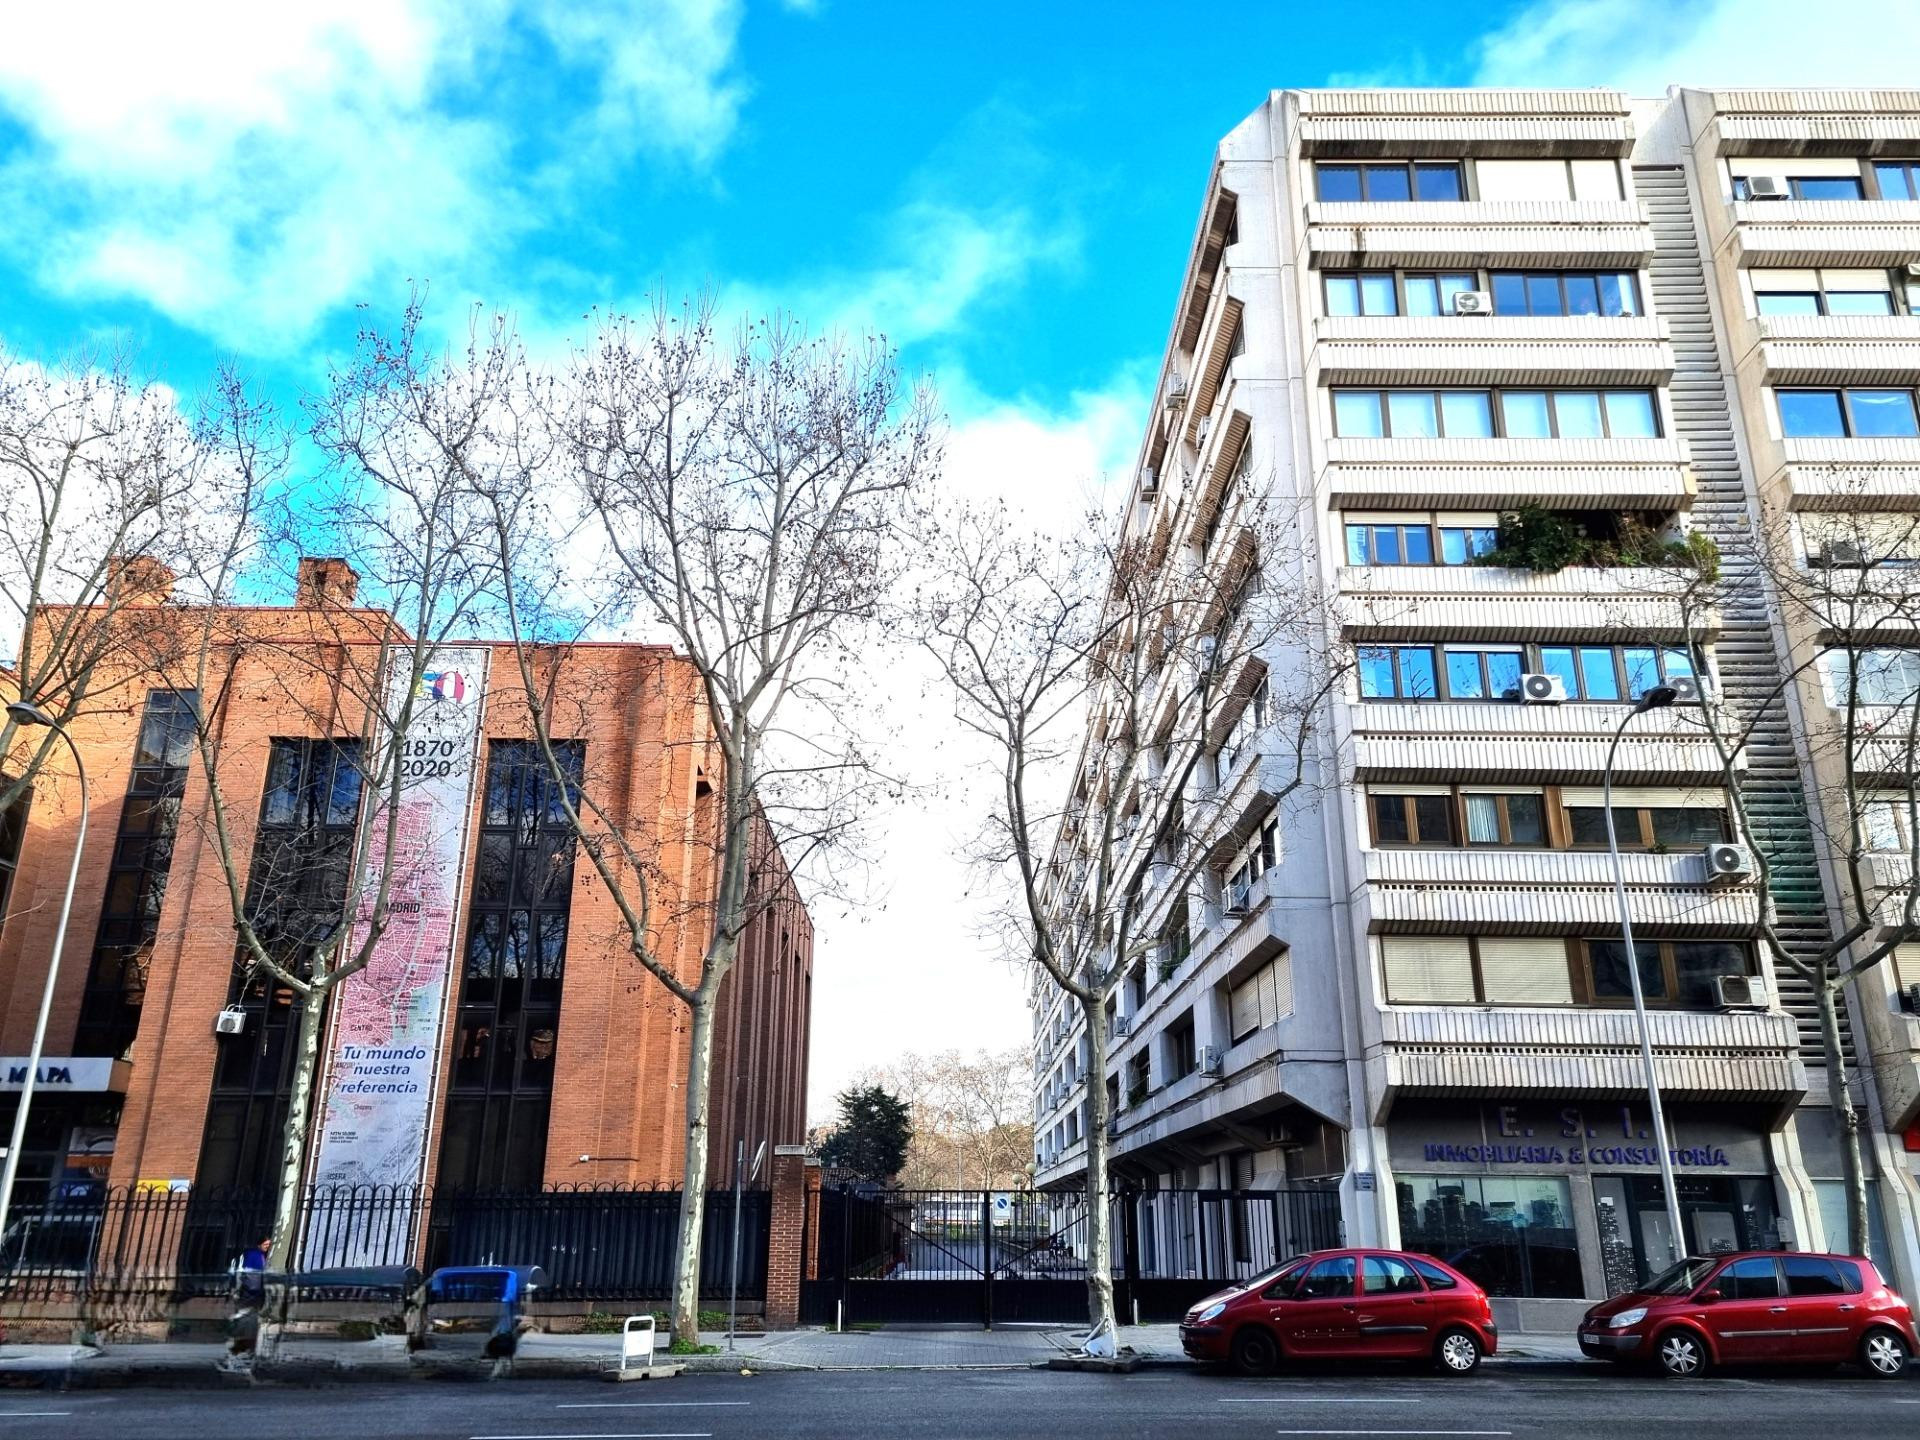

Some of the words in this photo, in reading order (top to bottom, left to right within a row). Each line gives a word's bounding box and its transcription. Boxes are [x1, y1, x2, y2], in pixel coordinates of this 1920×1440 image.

[402, 740, 453, 757] 1870
[400, 759, 451, 777] 2020
[343, 1046, 361, 1060] Tu
[366, 1045, 426, 1060] mundo
[353, 1064, 410, 1075] nuestra
[340, 1080, 418, 1093] referencia
[1423, 1143, 1565, 1164] INMOBILIARIA
[1568, 1144, 1585, 1165] &
[1589, 1144, 1730, 1166] CONSUTORÍA
